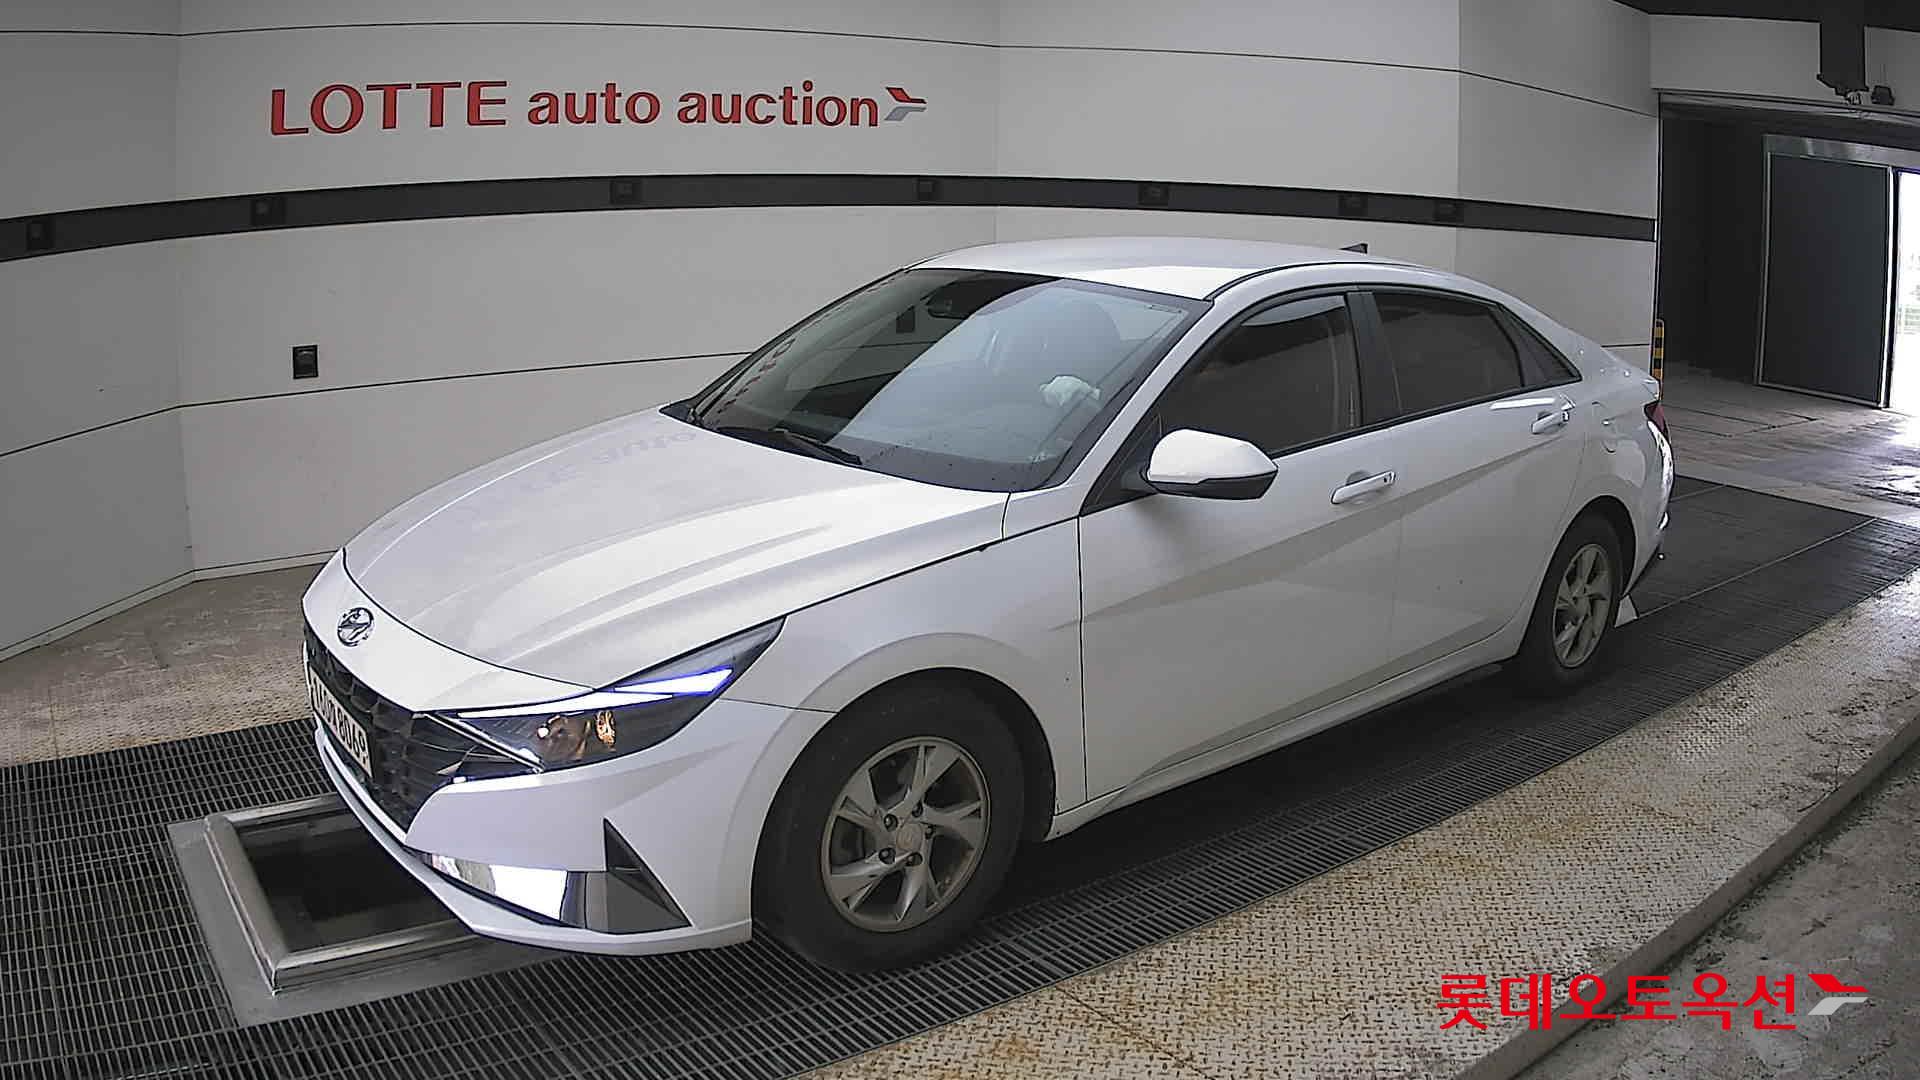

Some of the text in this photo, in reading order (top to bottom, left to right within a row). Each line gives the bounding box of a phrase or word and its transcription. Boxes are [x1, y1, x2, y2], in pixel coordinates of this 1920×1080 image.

[270, 80, 879, 135] LOTTE auto auction
